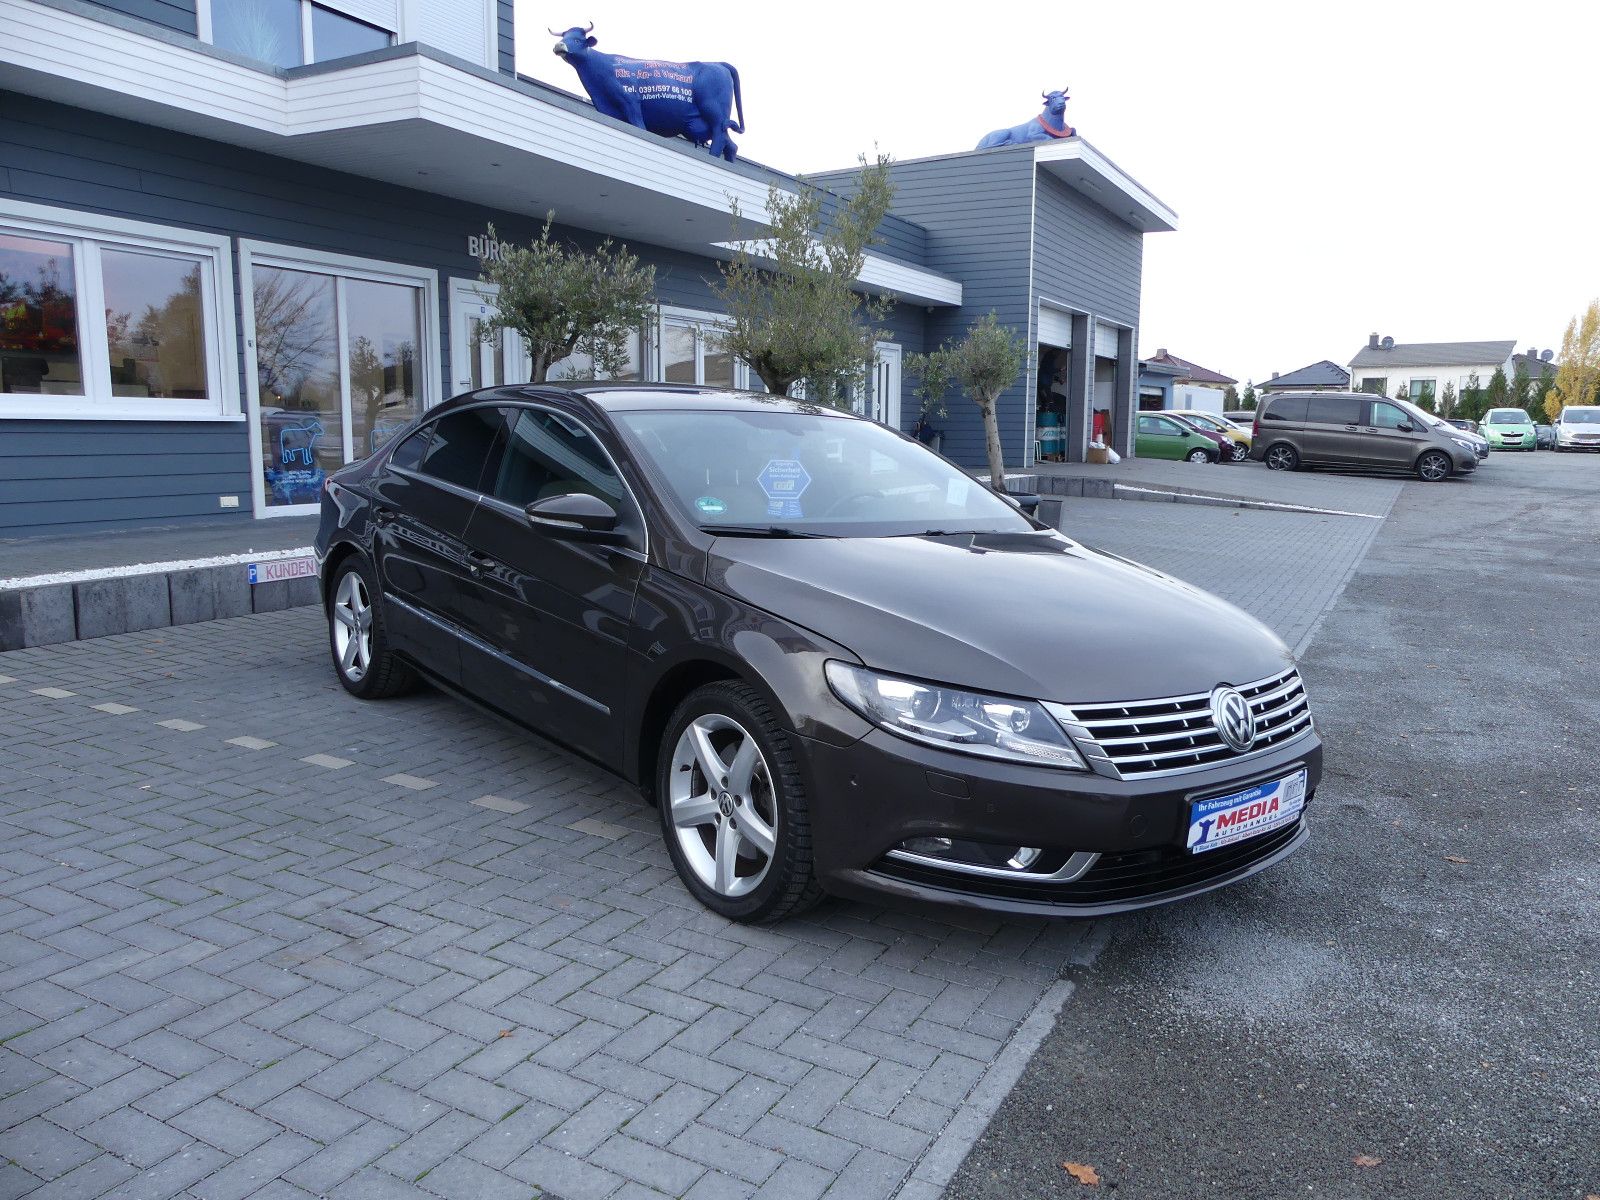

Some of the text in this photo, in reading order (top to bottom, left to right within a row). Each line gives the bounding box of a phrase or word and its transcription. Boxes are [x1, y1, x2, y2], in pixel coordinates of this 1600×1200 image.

[623, 85, 637, 93] Tel.
[639, 85, 670, 94] 0391/597
[681, 88, 692, 97] 100
[266, 560, 314, 579] KUNDEN
[1198, 803, 1208, 812] Ihr
[1216, 797, 1279, 830] MEDIA
[1214, 813, 1278, 838] AUTOHANDEL
